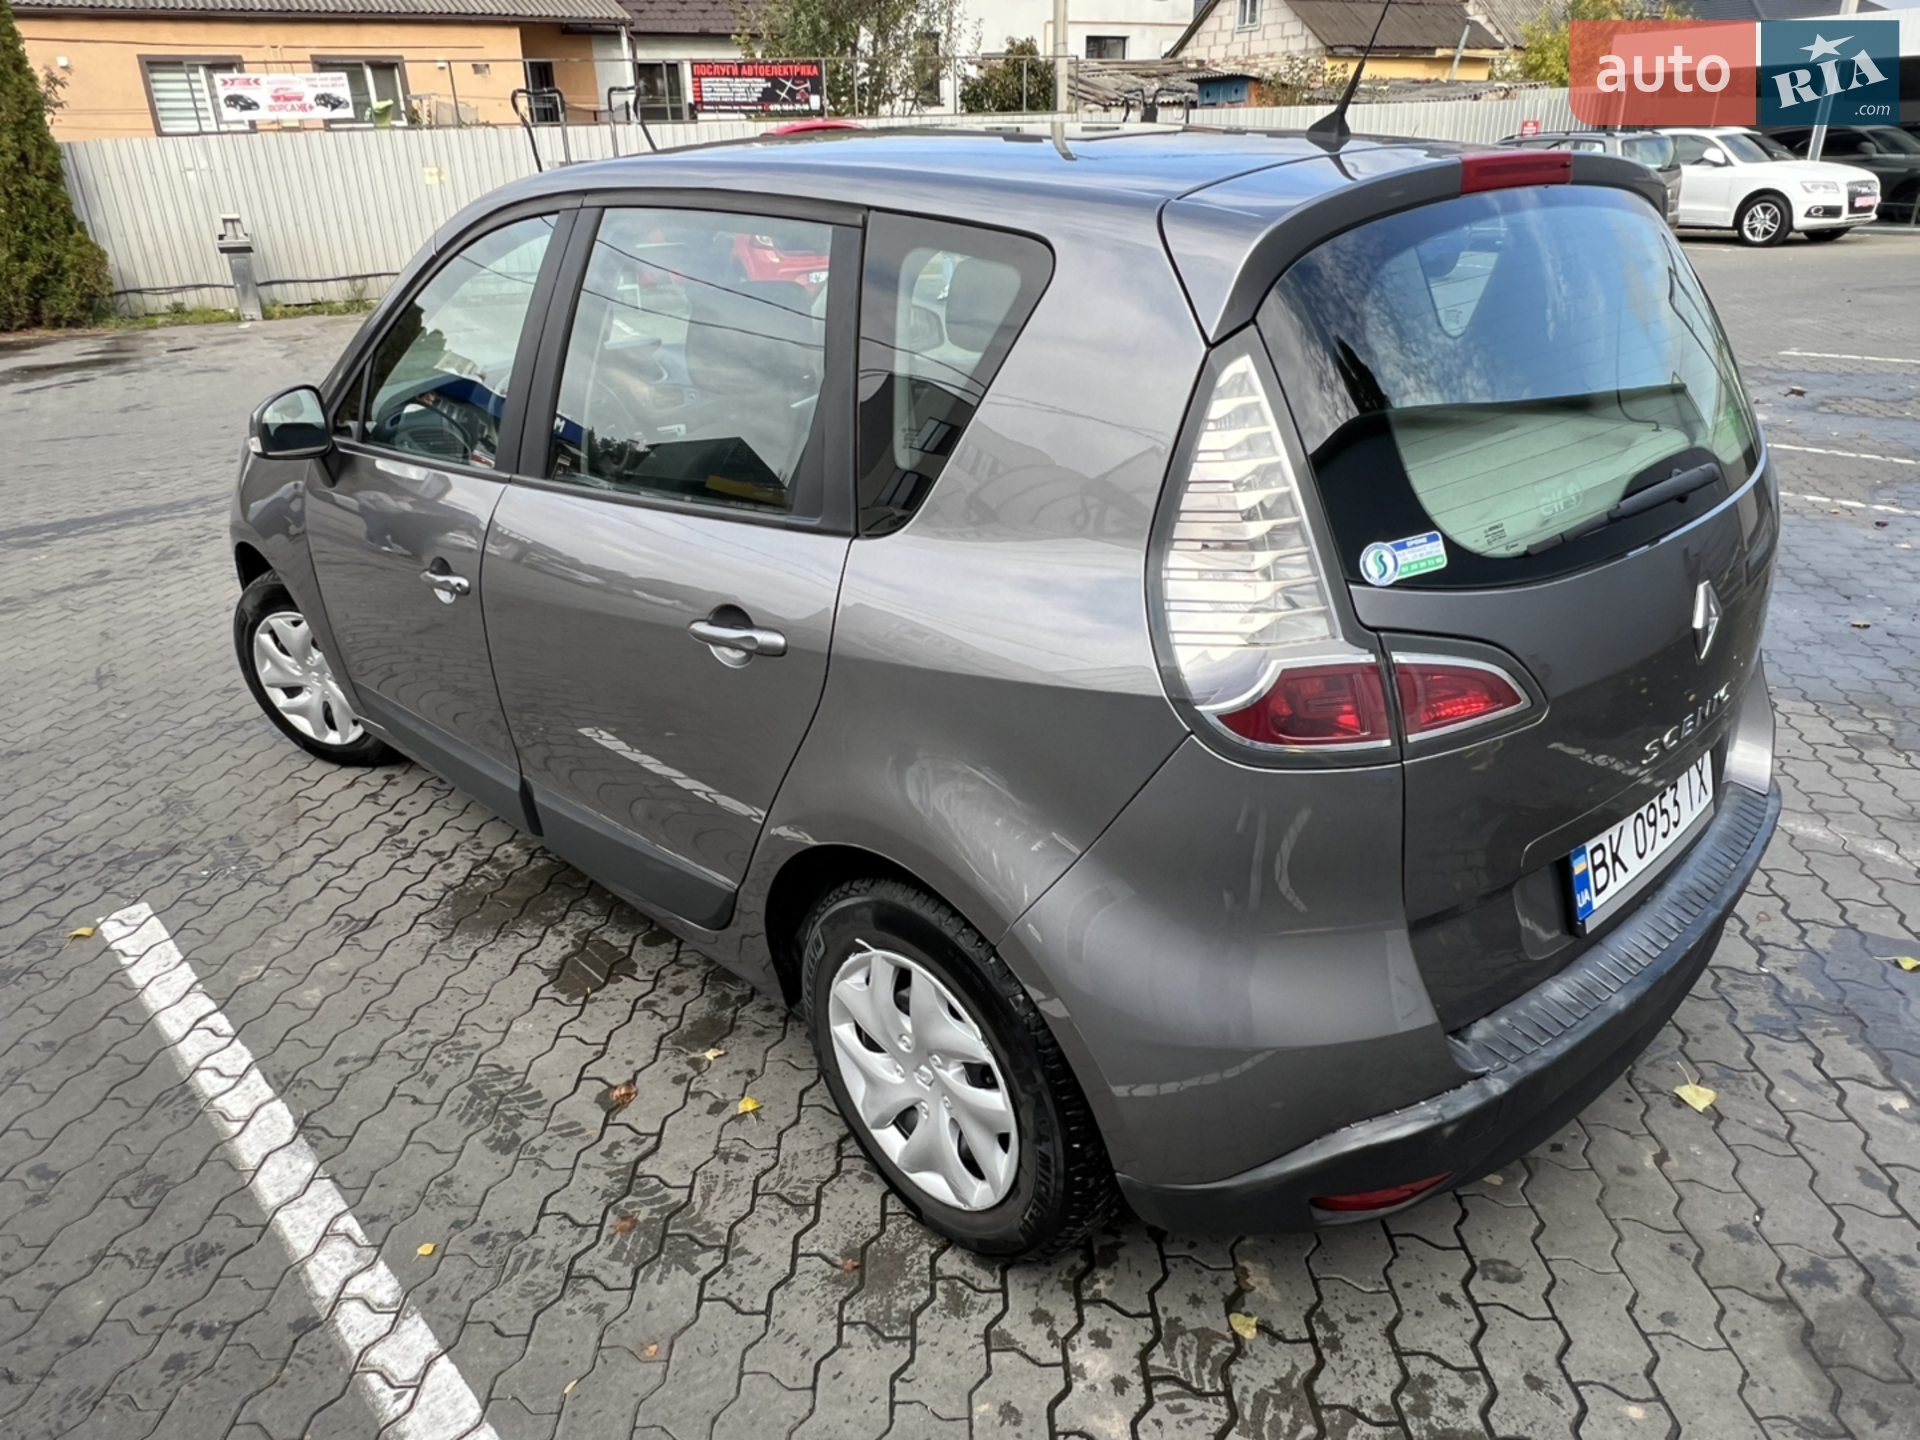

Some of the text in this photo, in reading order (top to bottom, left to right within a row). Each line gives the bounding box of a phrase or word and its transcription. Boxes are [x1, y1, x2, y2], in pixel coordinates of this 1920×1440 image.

[693, 64, 819, 77] ПОСЛУГИ АВТОЕЛЕКТРИКА
[1589, 755, 1709, 898] BK 0953 IX
[1577, 889, 1591, 908] UA
